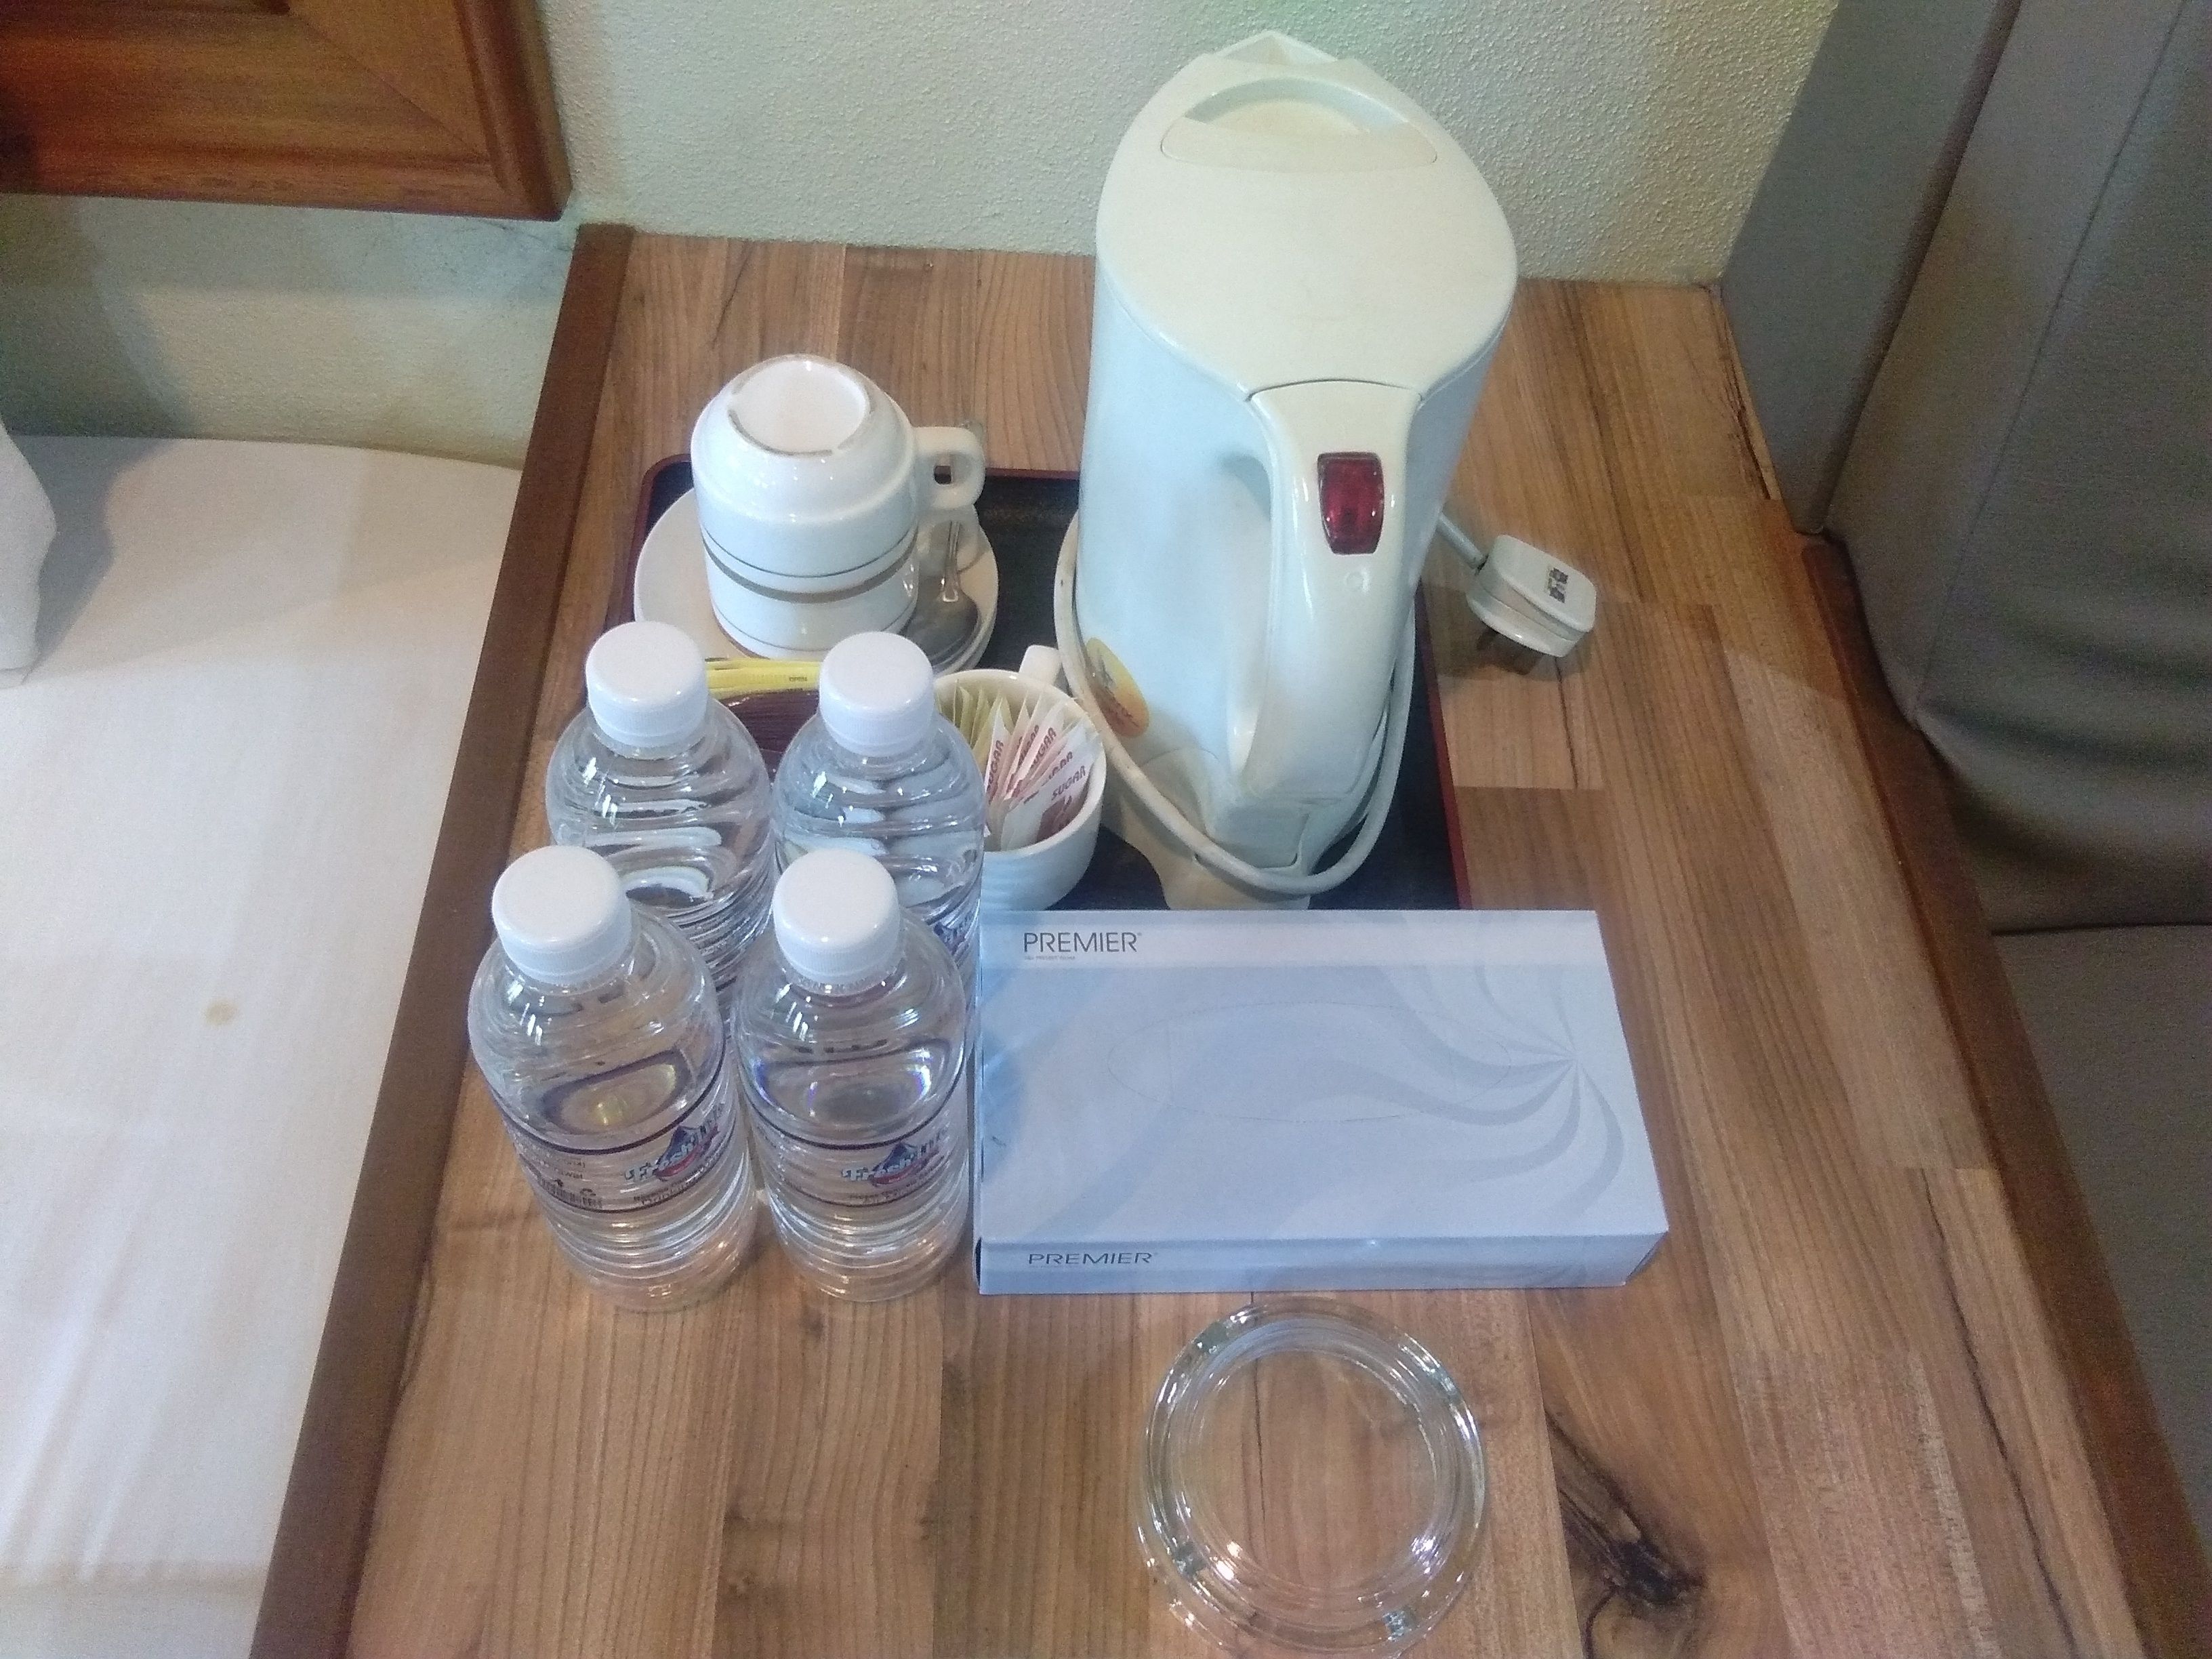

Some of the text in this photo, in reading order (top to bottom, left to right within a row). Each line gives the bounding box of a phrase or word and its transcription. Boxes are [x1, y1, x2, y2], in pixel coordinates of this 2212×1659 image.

[1052, 765, 1086, 800] SUGAR
[1023, 932, 1138, 953] PREMIER
[1028, 1252, 1153, 1265] PREMIER
